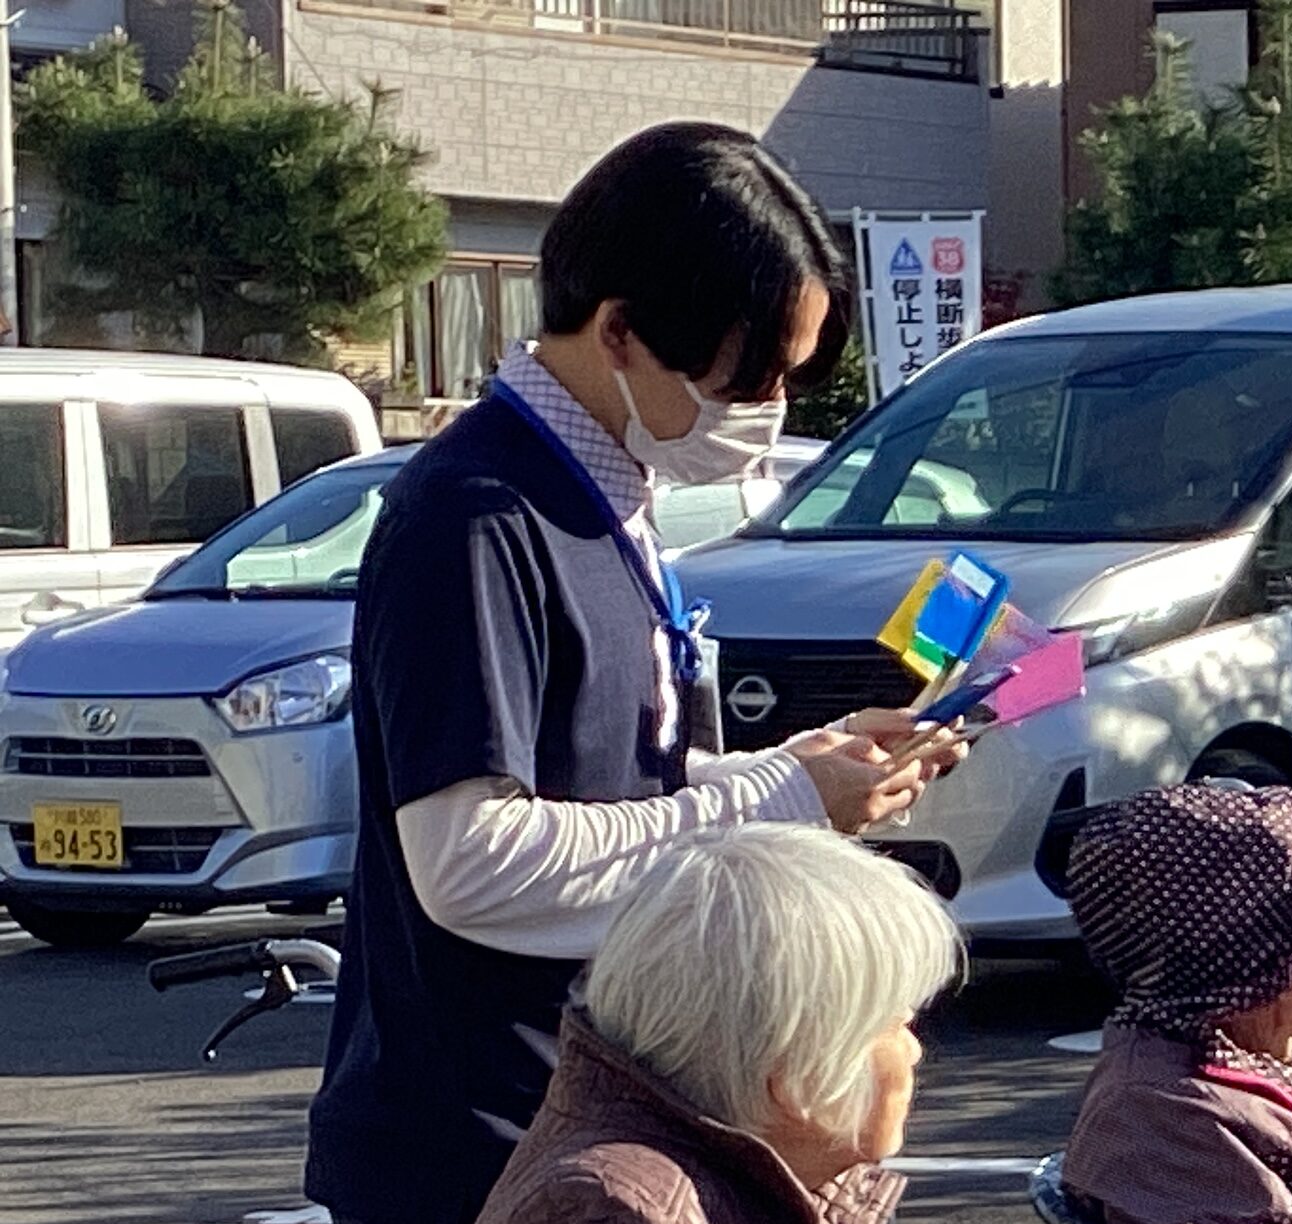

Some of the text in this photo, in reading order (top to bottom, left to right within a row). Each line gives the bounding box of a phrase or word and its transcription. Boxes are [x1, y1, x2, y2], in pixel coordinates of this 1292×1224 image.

[892, 279, 923, 379] 停止しよ
[935, 278, 964, 355] 横断歩
